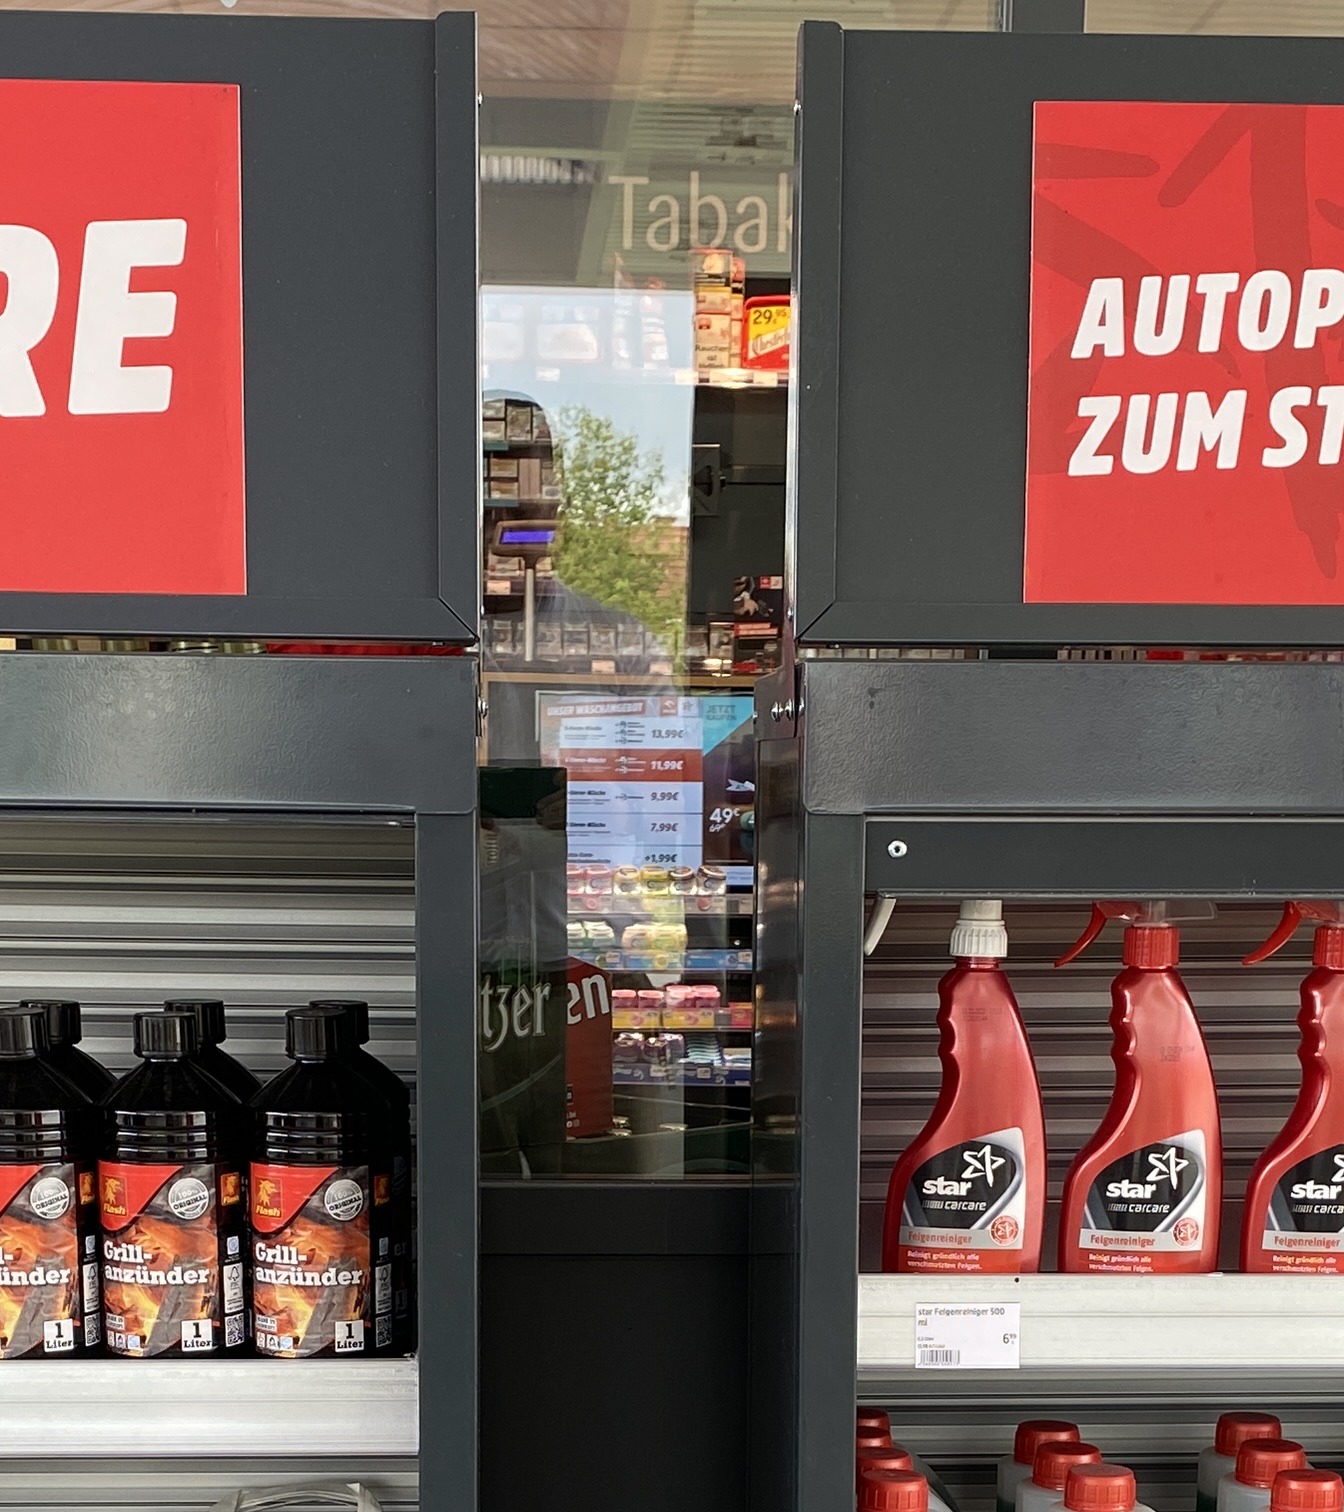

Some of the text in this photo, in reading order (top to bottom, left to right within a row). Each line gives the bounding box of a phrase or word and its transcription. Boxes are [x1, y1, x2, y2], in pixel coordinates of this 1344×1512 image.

[1068, 389, 1247, 477] ZUM
[922, 1176, 972, 1197] star
[1106, 1178, 1157, 1199] star
[945, 1200, 987, 1211] carcare
[908, 1230, 973, 1245] Felgenreiniger
[1090, 1234, 1155, 1248] Felgenreiniger
[104, 1242, 152, 1262] Grill-
[256, 1243, 307, 1262] Grill-
[105, 1266, 210, 1286] anzünder
[256, 1267, 362, 1287] anzünder
[935, 1308, 988, 1316] Felgenreiniger
[55, 1322, 64, 1338] 1
[192, 1322, 202, 1338] 1
[45, 1337, 73, 1350] Liter
[183, 1337, 211, 1349] Liter
